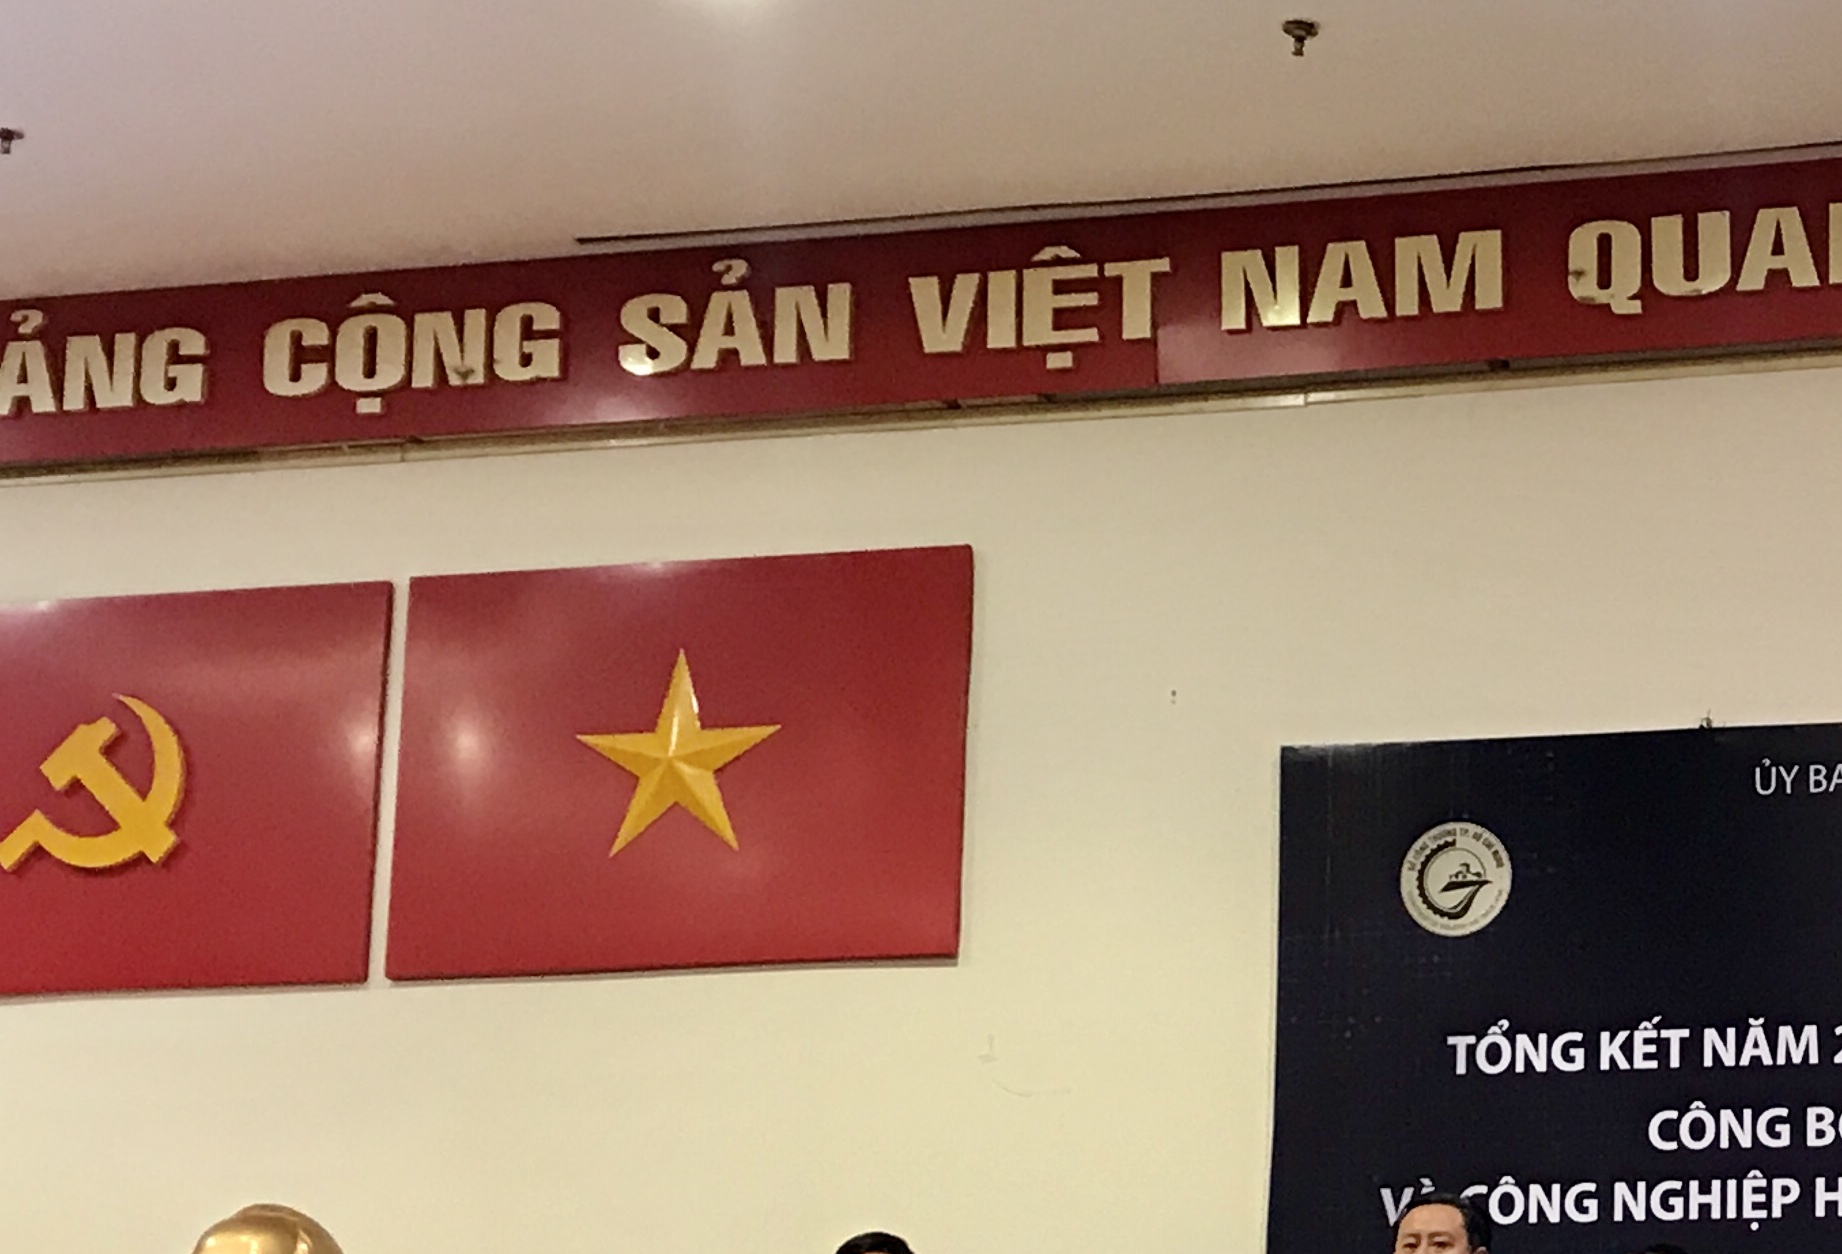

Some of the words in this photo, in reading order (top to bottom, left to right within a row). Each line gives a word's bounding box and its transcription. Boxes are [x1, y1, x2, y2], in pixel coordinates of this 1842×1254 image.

[263, 292, 560, 414] CỘNG
[618, 259, 851, 377] SẢN
[908, 245, 1170, 369] VIỆT
[1220, 230, 1503, 331] NAM
[1755, 758, 1800, 795] ỦY
[1447, 1019, 1585, 1075] TỔNG
[1599, 1015, 1690, 1071] KẾT
[1703, 1017, 1819, 1068] NĂM
[1648, 1100, 1791, 1151] CÔNG
[1379, 1177, 1436, 1227] V
[1613, 1169, 1801, 1231] NGHIỆP
